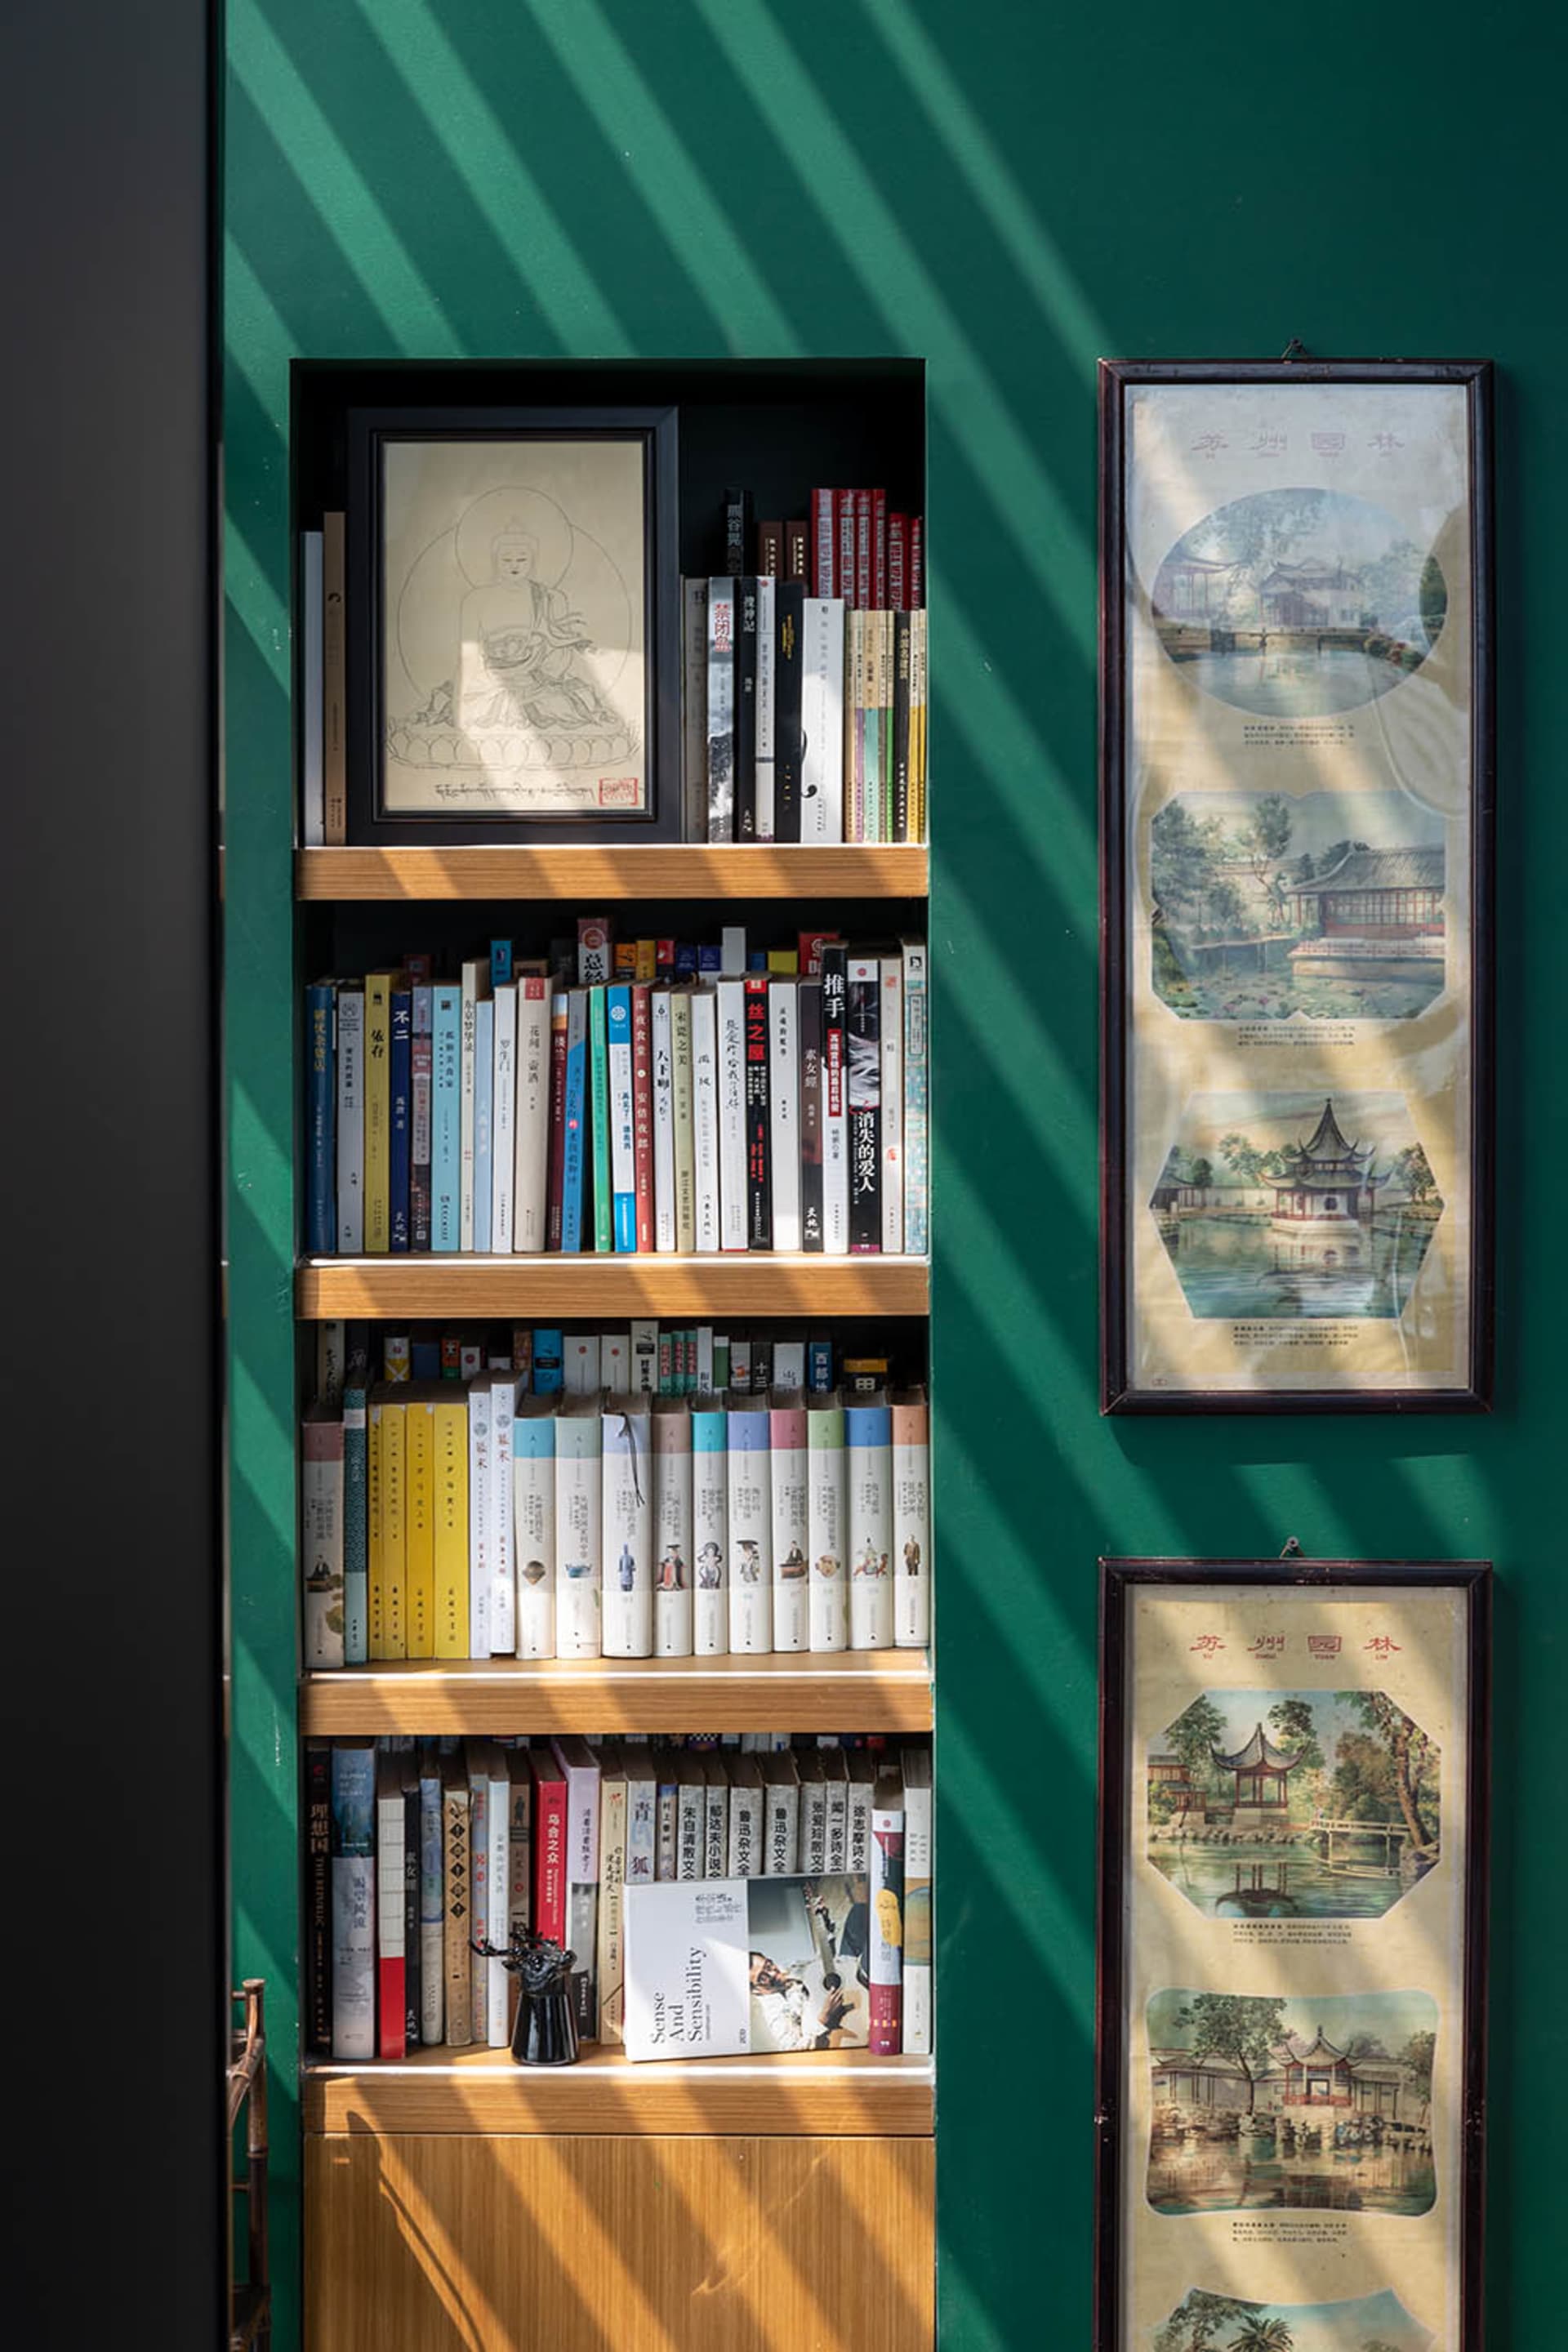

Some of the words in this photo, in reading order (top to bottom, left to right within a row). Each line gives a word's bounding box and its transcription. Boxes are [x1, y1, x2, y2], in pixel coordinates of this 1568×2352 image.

[823, 973, 845, 1019] 推手
[394, 1010, 410, 1040] 不二
[636, 999, 648, 1056] 深夜食堂
[858, 1111, 876, 1193] 消失的爱人
[1189, 1635, 1403, 1652] 苏州园林
[310, 1802, 329, 1854] 理想国
[546, 1813, 560, 1864] 乌合之众
[737, 1809, 751, 1876] 鲁迅杂文全
[773, 1807, 787, 1873] 鲁迅杂文全
[650, 1991, 666, 2044] Sense
[685, 1946, 707, 2042] Sensibility
[667, 2004, 684, 2042] And
